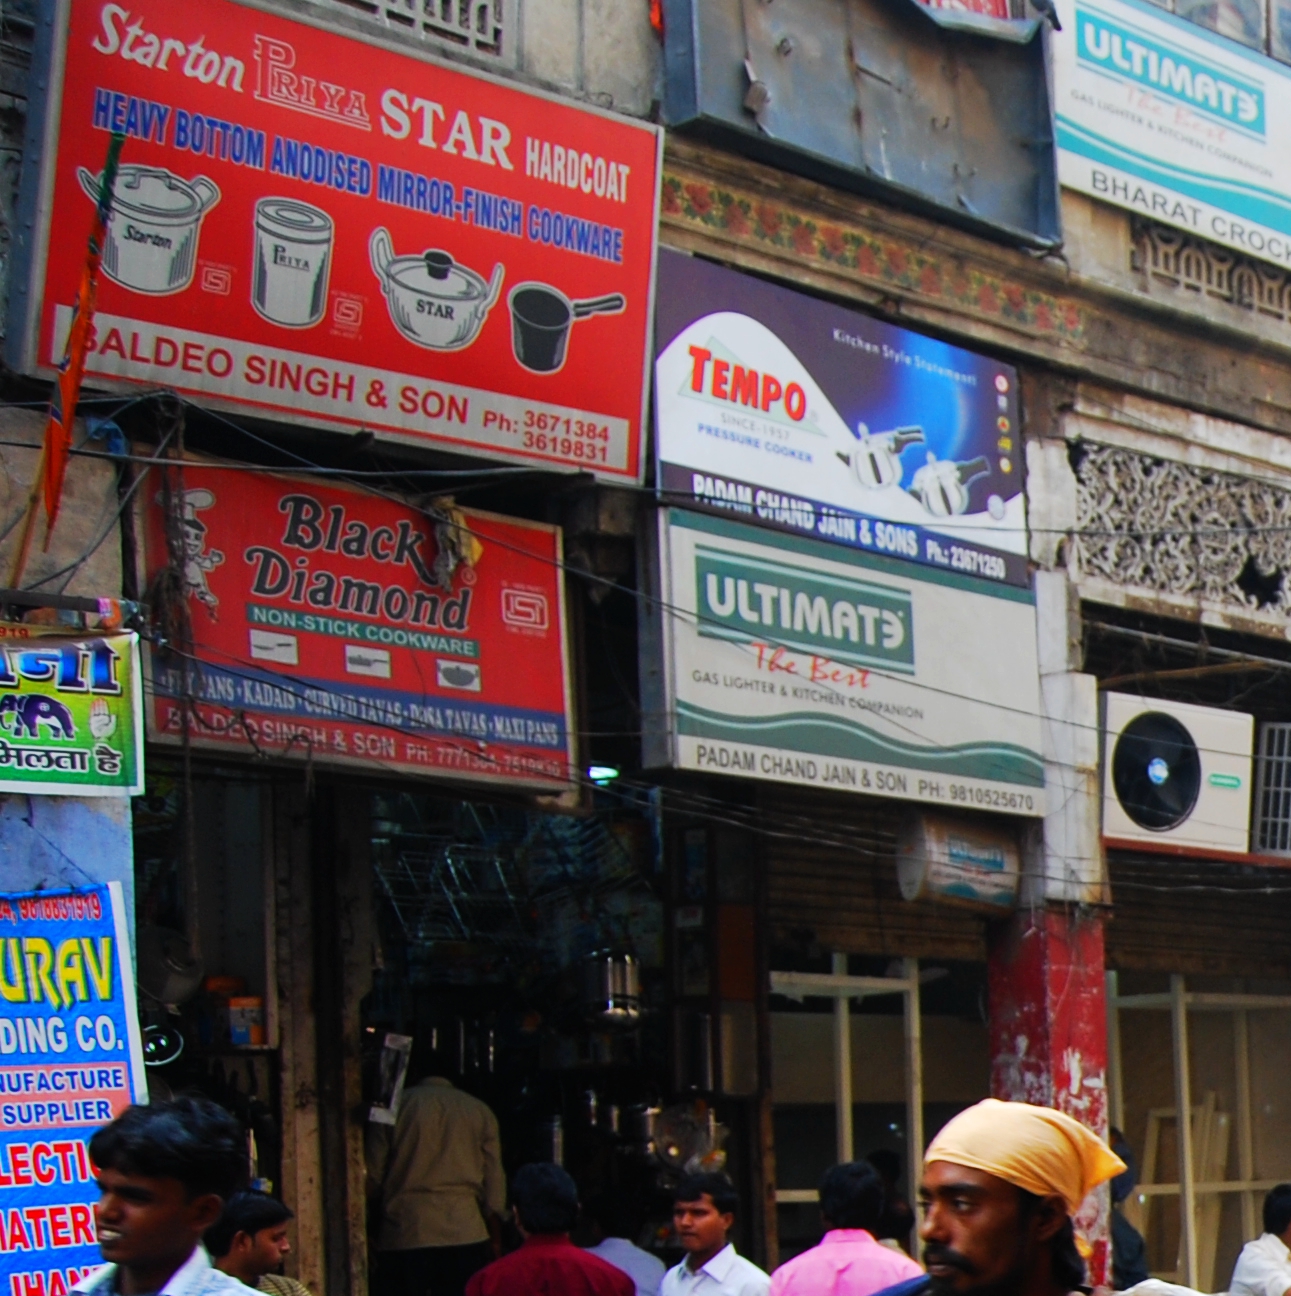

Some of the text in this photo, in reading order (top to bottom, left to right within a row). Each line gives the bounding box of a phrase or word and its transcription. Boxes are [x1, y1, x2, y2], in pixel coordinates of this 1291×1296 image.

[1084, 21, 1259, 122] ULTIMATE
[92, 3, 631, 203] Starton PRIYA STAR HARDCOAT
[1071, 88, 1094, 107] GAS
[1097, 96, 1143, 126] LIGHTER
[1157, 124, 1204, 151] KITCHEN
[92, 87, 624, 264] HEAVY BOTTOM ANODISED MIRROR-FINISH COOKWARE
[1091, 168, 1203, 226] BHARAT
[122, 223, 173, 251] Starton
[272, 243, 311, 270] PRIYA
[415, 300, 455, 321] STAR
[833, 328, 880, 354] Kitchen
[882, 344, 912, 366] Style
[243, 354, 356, 402] SINGH
[365, 379, 388, 409] &
[398, 385, 470, 425] SON
[482, 409, 519, 434] Ph:
[523, 409, 610, 443] 3671384
[688, 343, 807, 422] TEMPO
[522, 431, 609, 463] 3619831
[697, 422, 813, 464] PRESSURE COOKER
[720, 411, 791, 441] SINCE-1957
[278, 493, 440, 587] Black
[692, 473, 753, 515] PADAM
[756, 489, 815, 530] CHAND
[818, 506, 857, 543] JAIN
[859, 519, 872, 545] &
[875, 524, 918, 557] SONS
[244, 545, 472, 633] Diamond
[705, 572, 905, 650] ULTIMATE
[252, 605, 476, 656] NON-STICK COOKWARE
[750, 641, 872, 690] The Best
[243, 679, 297, 710] KADAIS
[303, 688, 357, 717] CURVED
[359, 696, 403, 724] TAVAS
[409, 703, 443, 729] DOSA
[445, 708, 488, 737] TAVAS
[493, 715, 526, 742] MAXI
[526, 719, 559, 746] PANS
[692, 670, 924, 720] GAS LIGHTER & KITCHEN COMPANION
[93, 744, 121, 775] है
[262, 719, 327, 749] SINGH
[333, 729, 347, 752] &
[353, 730, 396, 758] SON
[405, 742, 433, 764] PH:
[696, 744, 1034, 811] PADAM CHAND JAIN & SON PH: 9810525670
[75, 1014, 124, 1053] CO.
[3, 1100, 114, 1126] SUPPLIER
